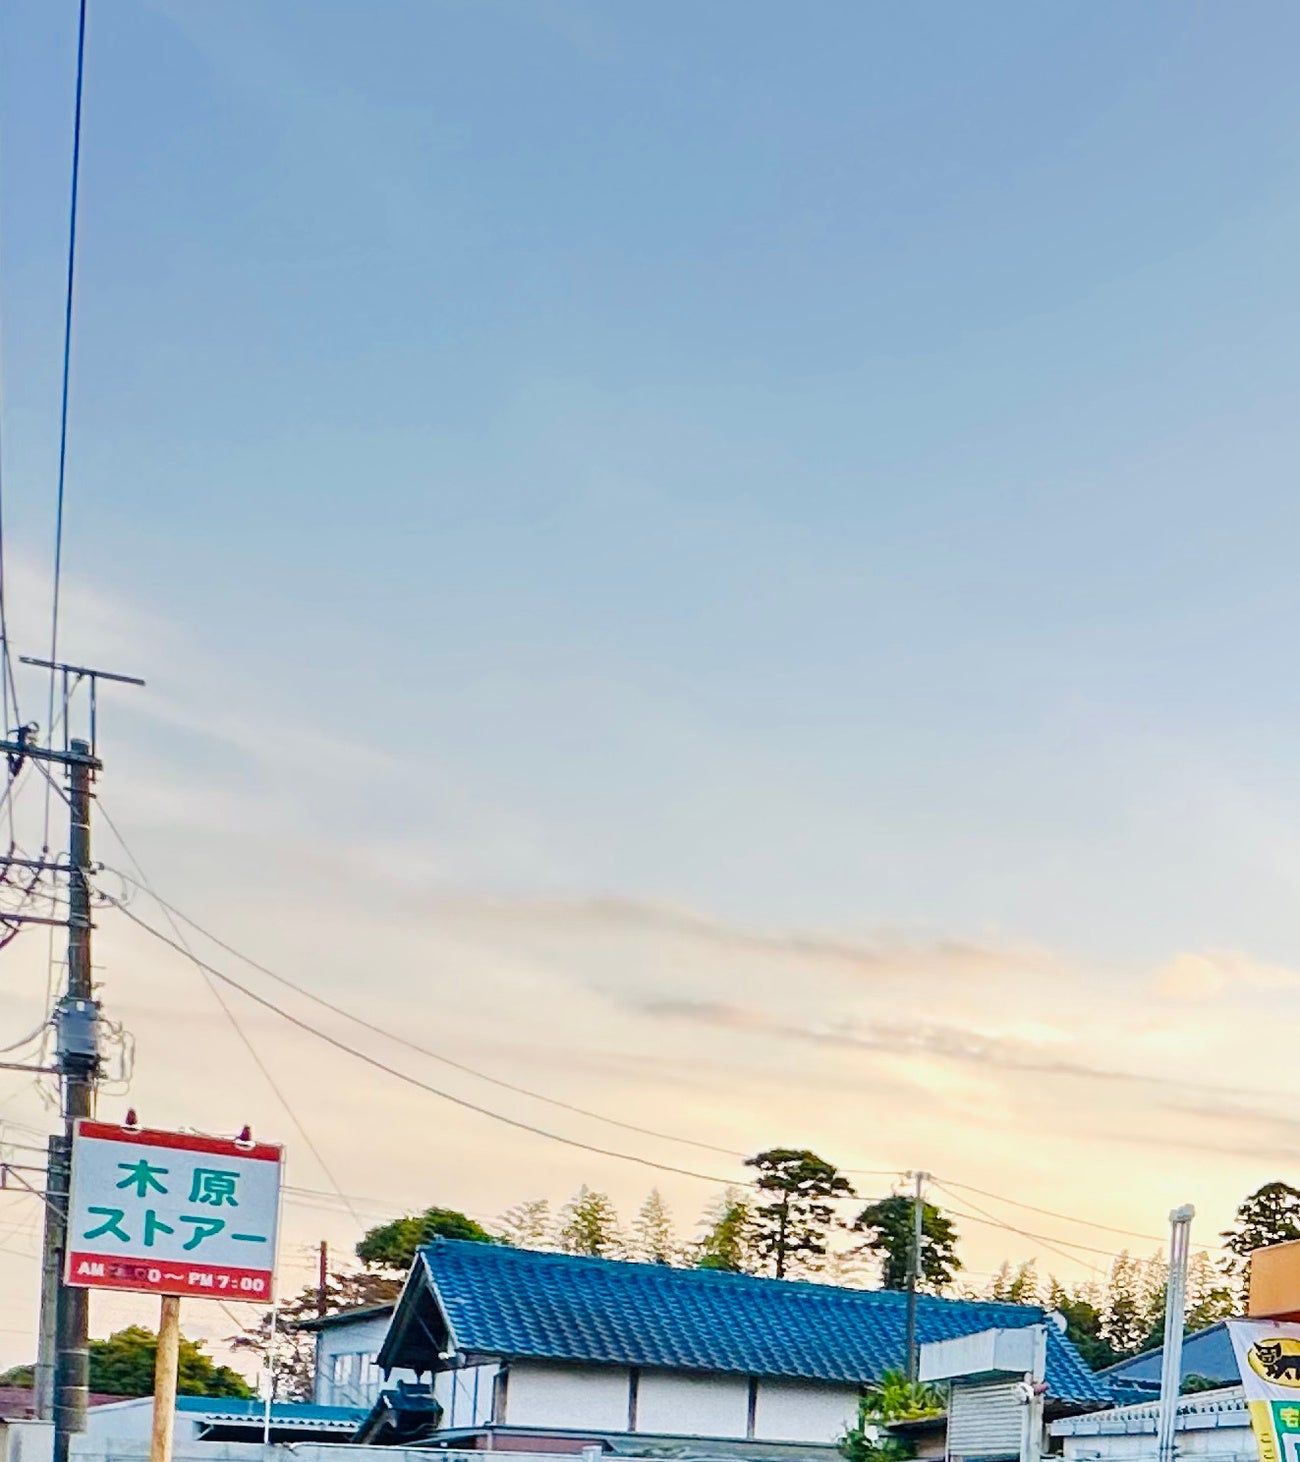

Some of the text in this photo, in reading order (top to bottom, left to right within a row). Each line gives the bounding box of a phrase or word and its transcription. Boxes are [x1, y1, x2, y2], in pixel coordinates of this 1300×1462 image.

[116, 1159, 241, 1207] 木原
[83, 1206, 267, 1250] ストアー
[77, 1261, 105, 1277] AM
[188, 1272, 213, 1287] PM
[217, 1274, 265, 1292] 7:00
